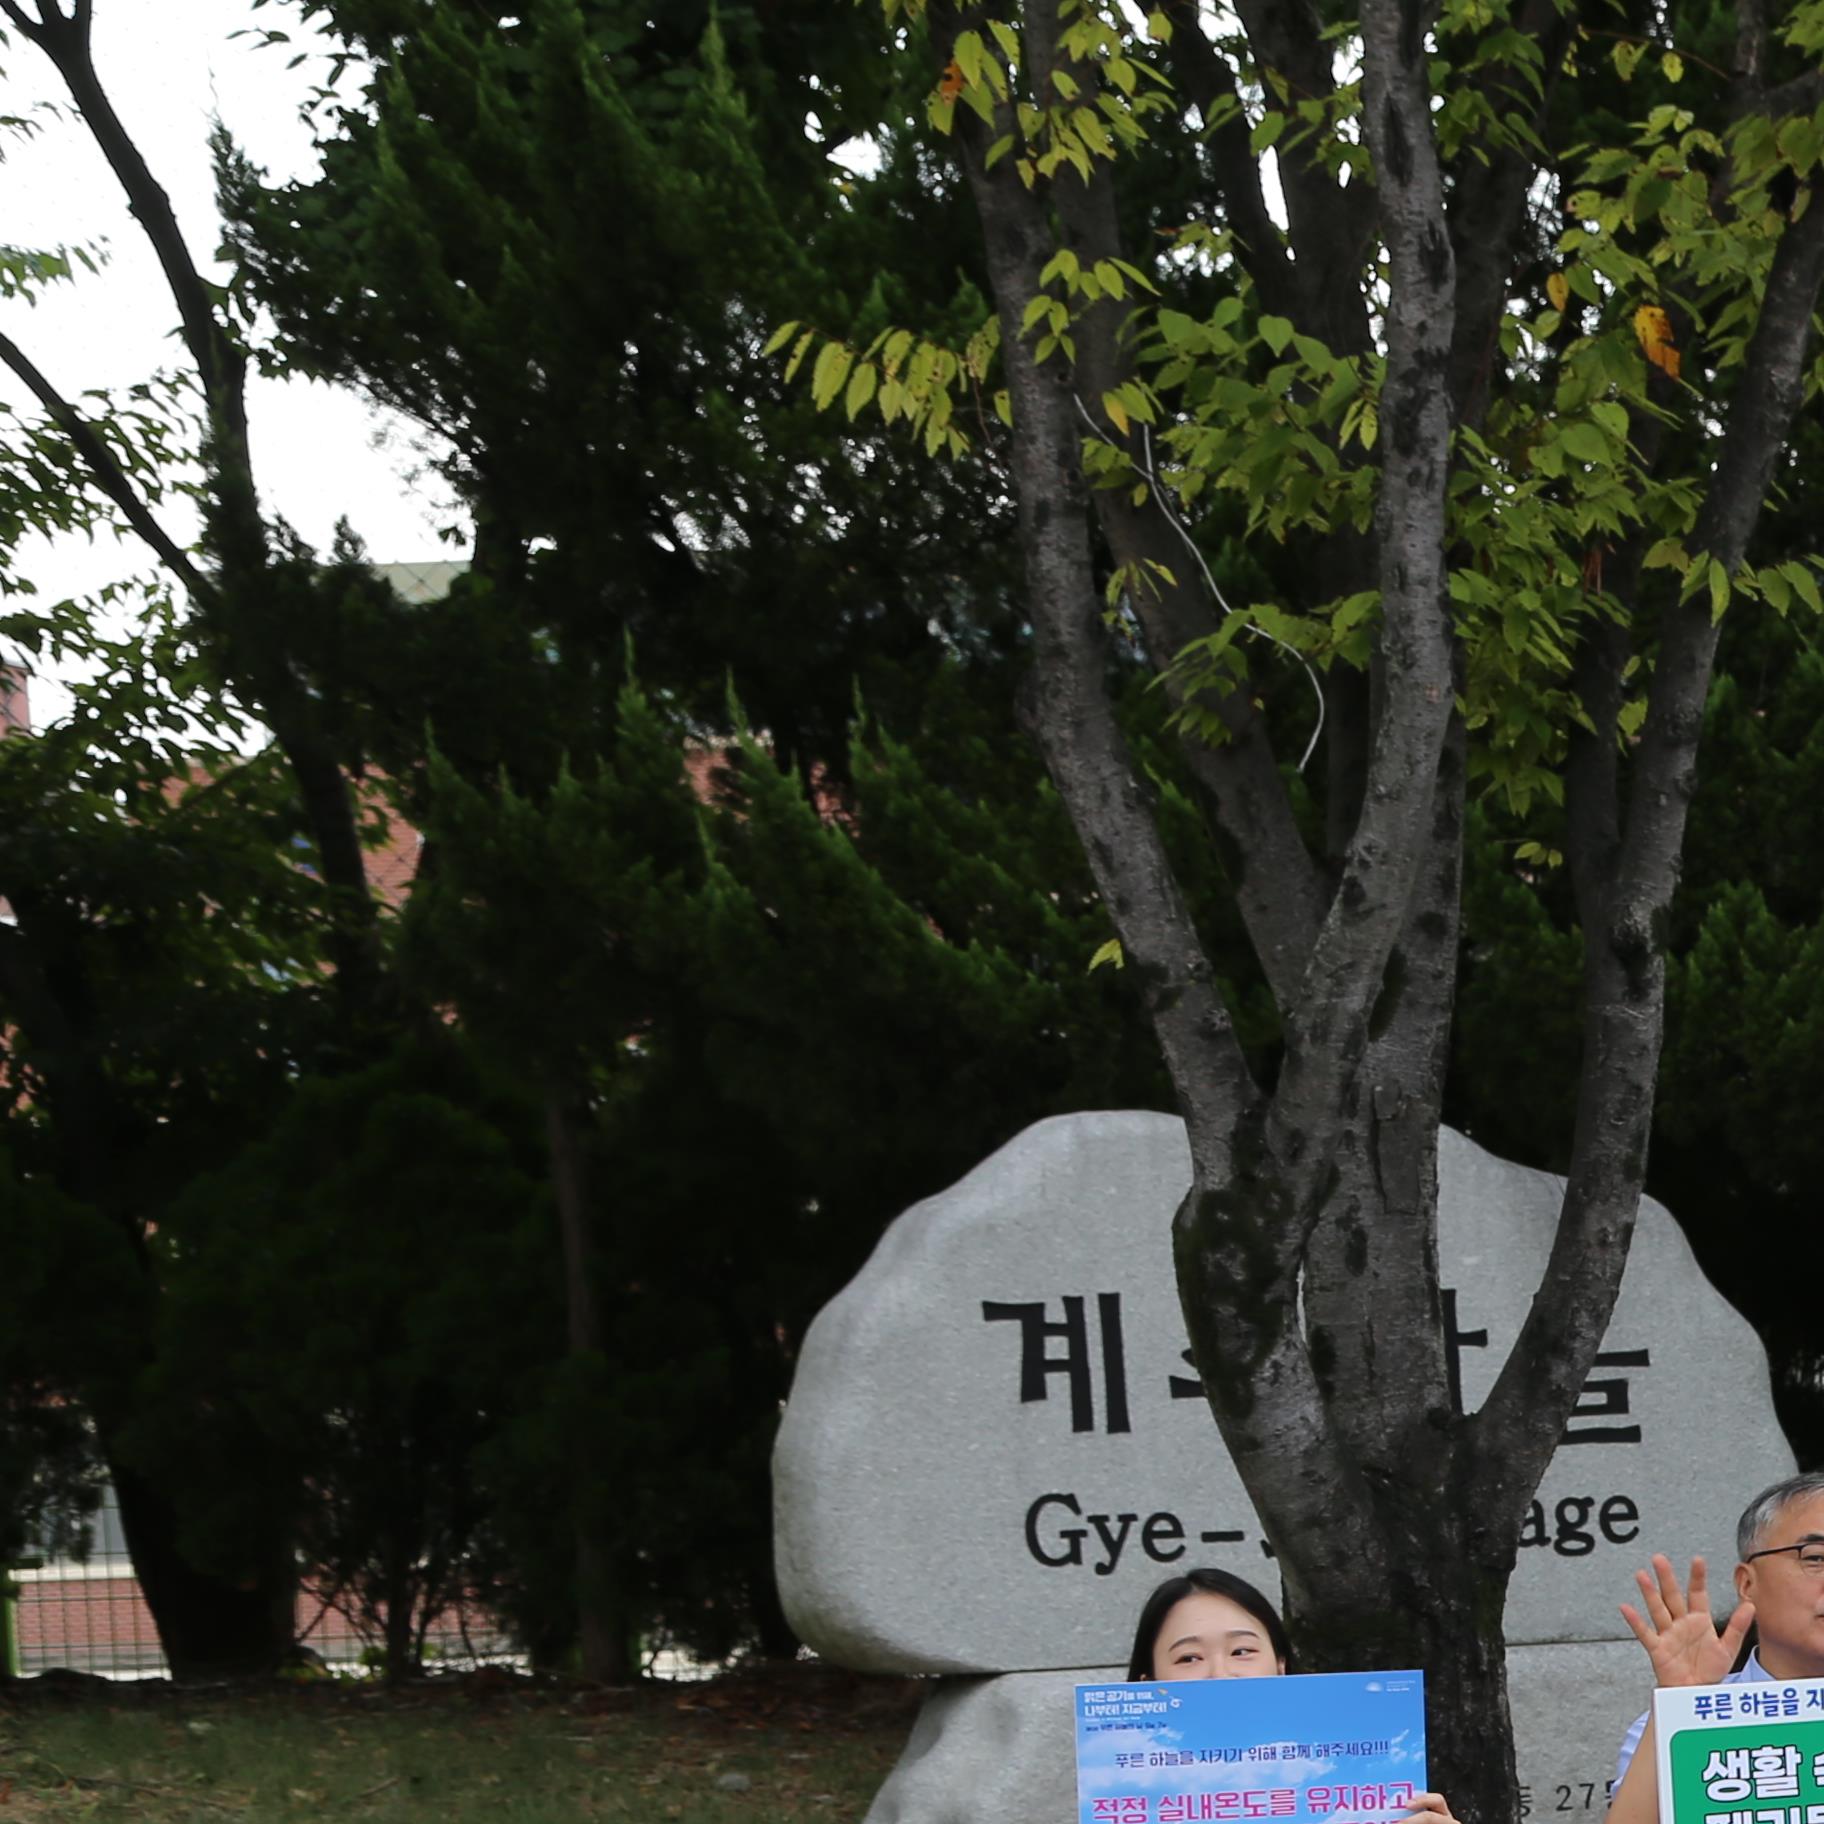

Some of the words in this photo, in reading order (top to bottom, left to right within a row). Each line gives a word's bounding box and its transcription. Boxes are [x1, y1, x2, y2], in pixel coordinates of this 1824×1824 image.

[1694, 1692, 1733, 1721] 푸른
[1739, 1690, 1799, 1718] 하늘을
[1114, 1752, 1145, 1768] 푸른
[1149, 1749, 1194, 1767] 하늘을
[1200, 1746, 1242, 1764] 지키기
[1248, 1745, 1278, 1762] 위해
[1282, 1742, 1311, 1760] 함께
[1701, 1745, 1802, 1803] 생활
[1091, 1795, 1148, 1824] 적정
[1158, 1788, 1297, 1823] 실내온도를
[1306, 1780, 1414, 1816] 유지하고
